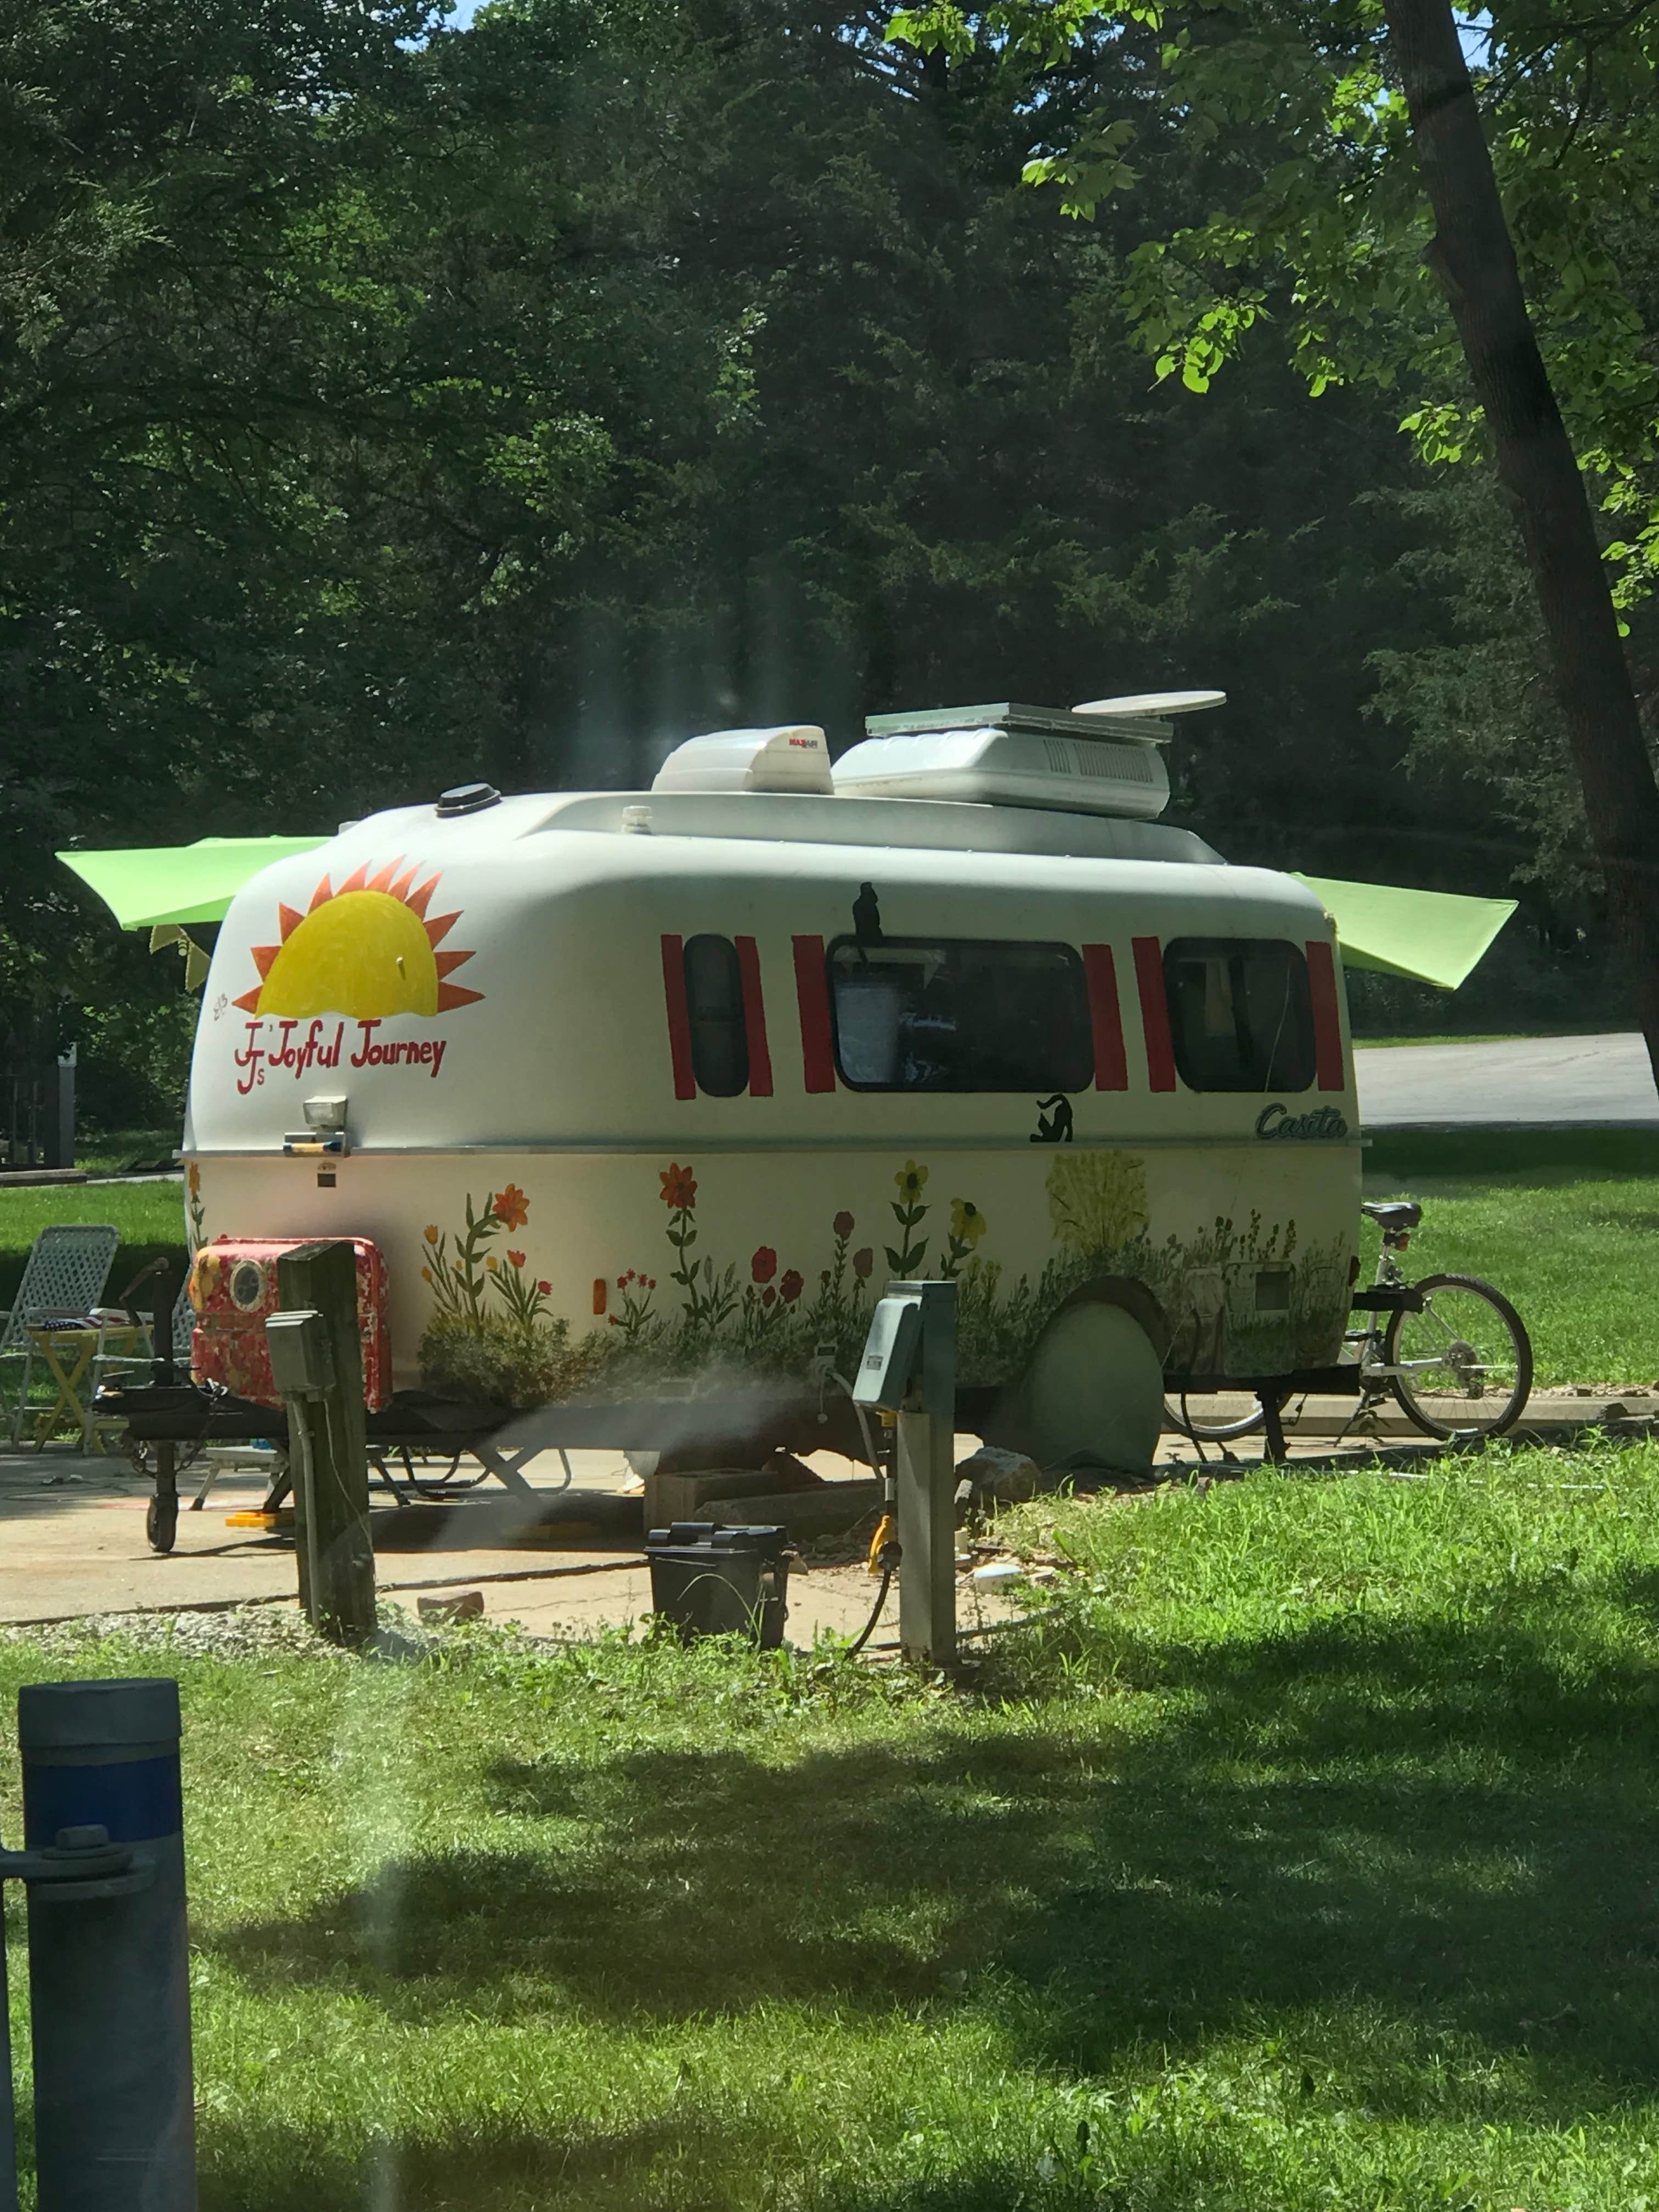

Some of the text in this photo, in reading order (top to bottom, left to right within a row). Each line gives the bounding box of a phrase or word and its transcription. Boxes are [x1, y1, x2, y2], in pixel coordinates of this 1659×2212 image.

[268, 1020, 345, 1079] Joyful
[351, 1019, 447, 1077] Journey
[1256, 1103, 1347, 1139] Casita
